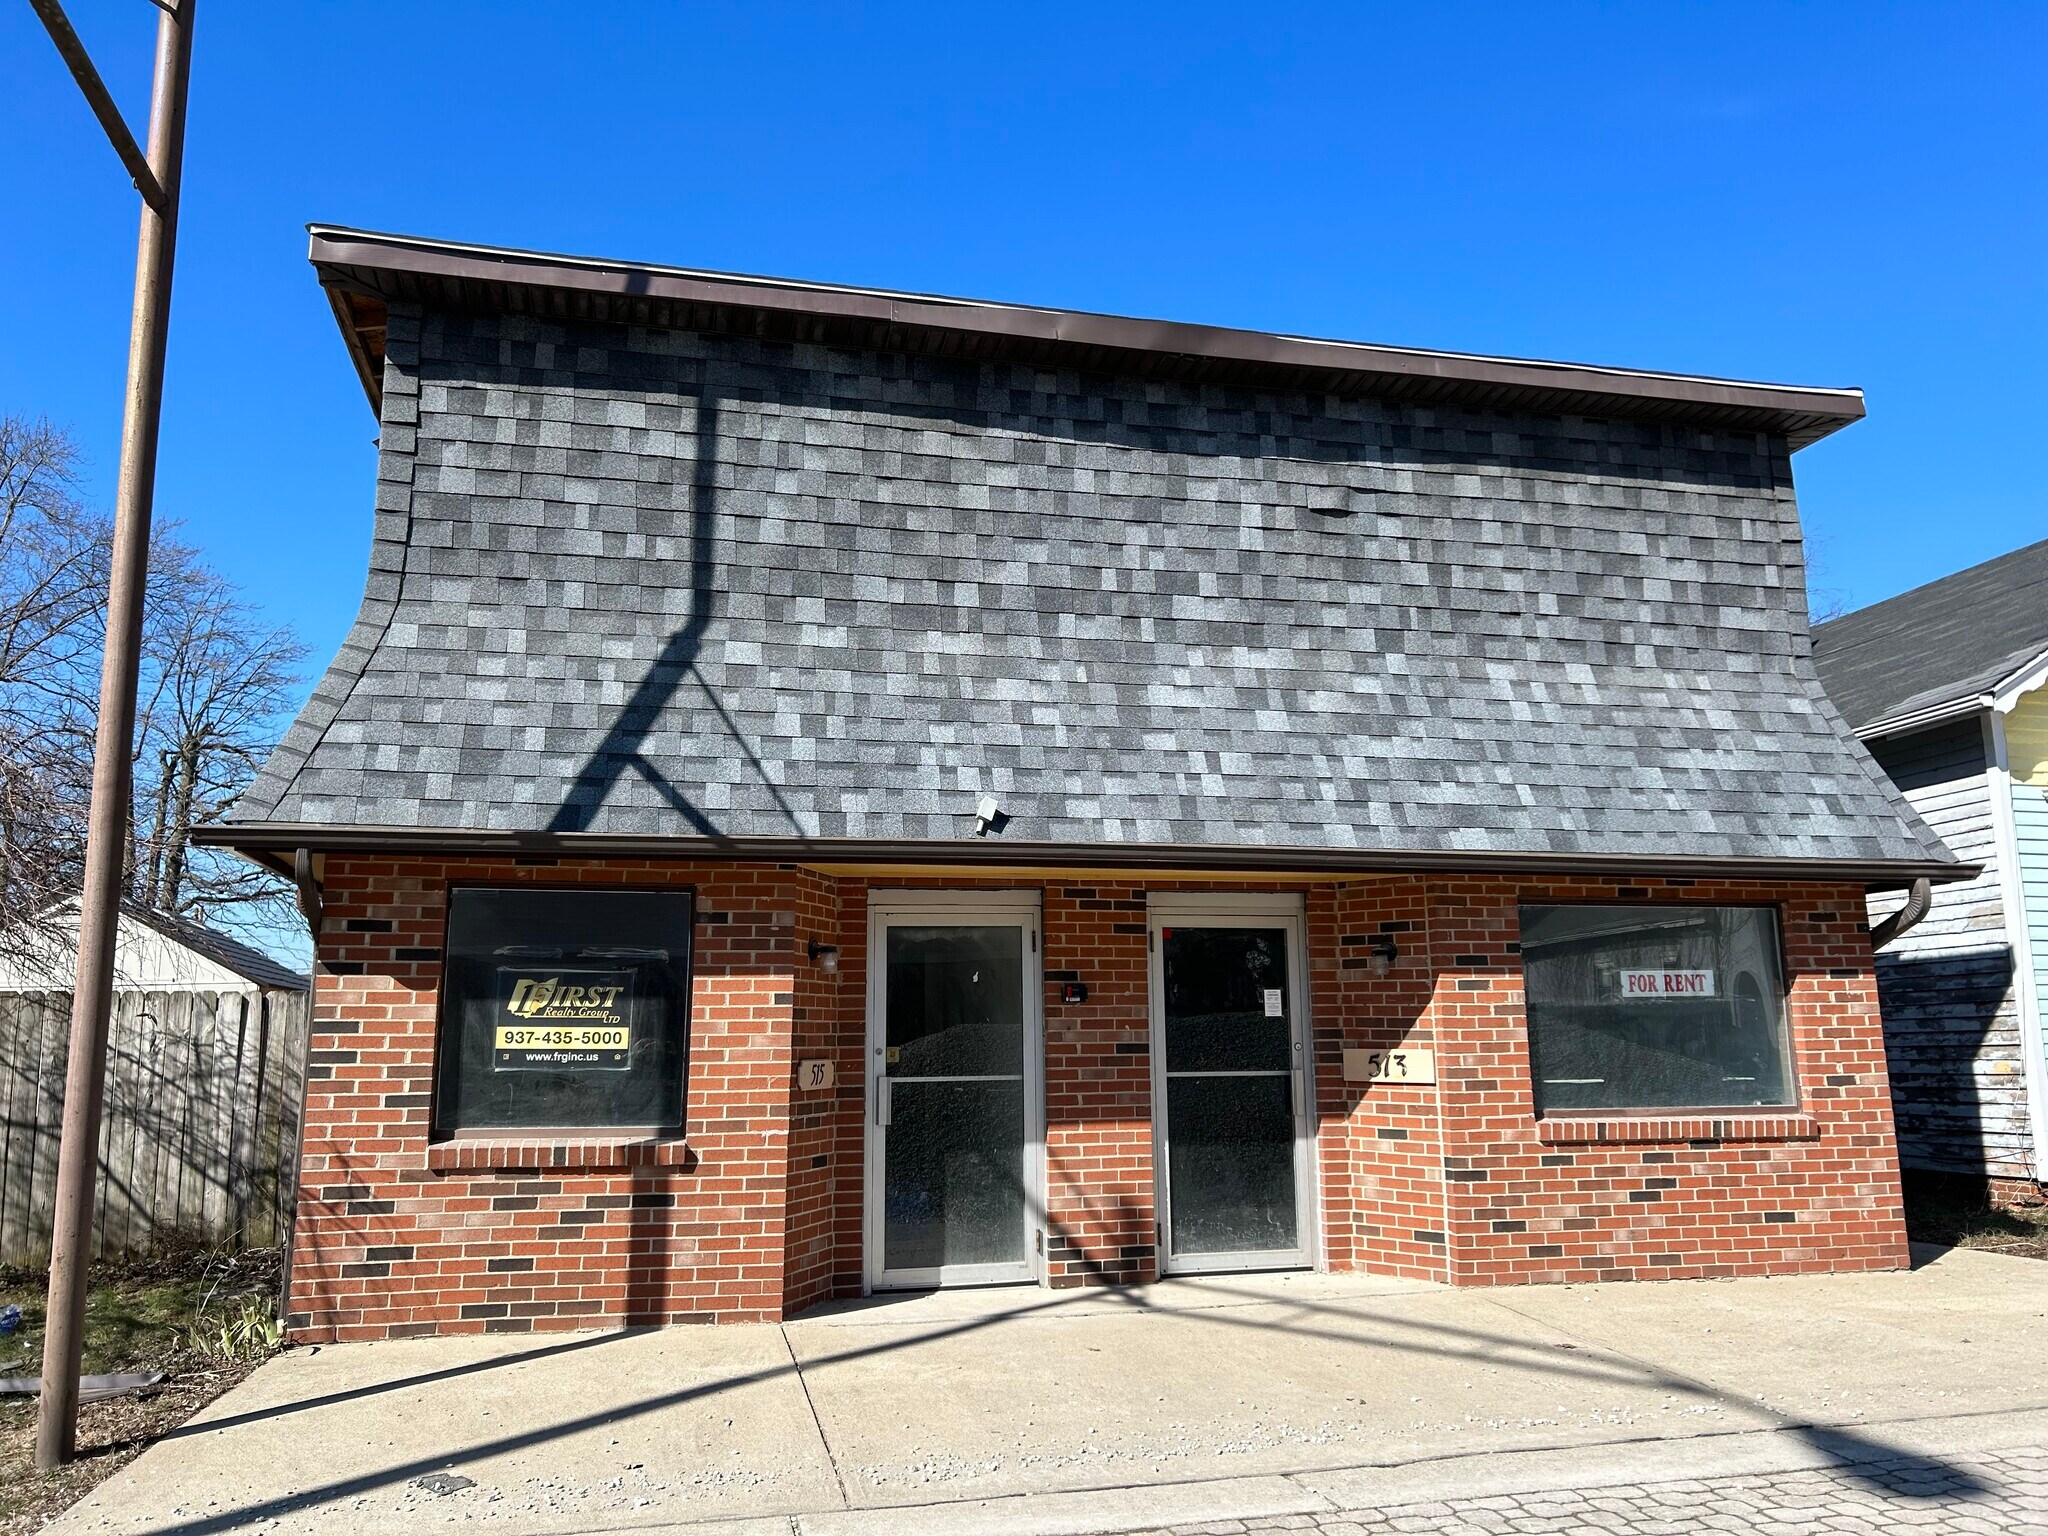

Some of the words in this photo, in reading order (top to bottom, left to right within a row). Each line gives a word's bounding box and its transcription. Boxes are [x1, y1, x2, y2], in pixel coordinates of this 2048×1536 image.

[1627, 974, 1658, 992] FOR
[1663, 974, 1707, 992] RENT
[545, 1007, 577, 1018] Realty
[578, 1007, 610, 1019] Group
[603, 1015, 621, 1024] LTD
[505, 1031, 622, 1045] 937-435-5000
[526, 1052, 599, 1063] www.frginc.us
[1368, 1054, 1408, 1078] 513
[810, 1063, 825, 1086] 515
